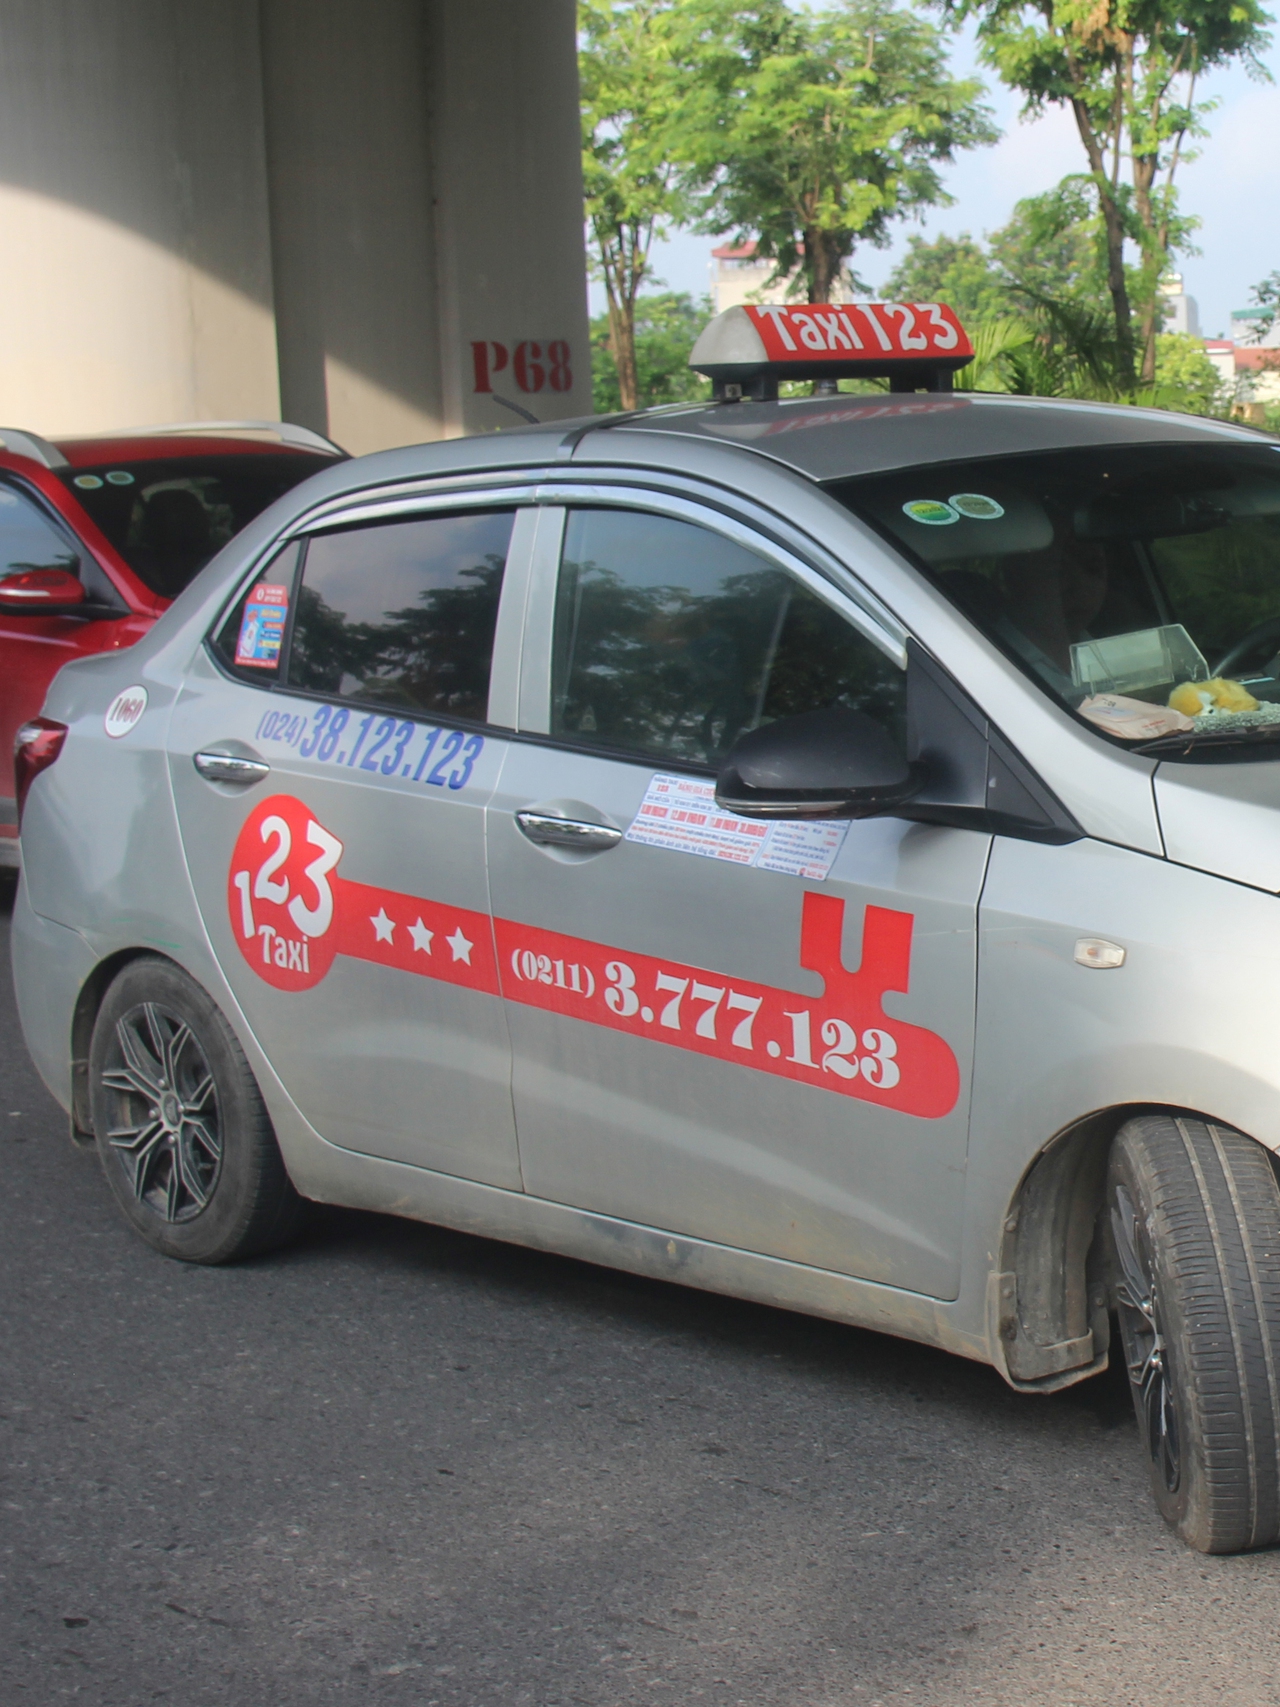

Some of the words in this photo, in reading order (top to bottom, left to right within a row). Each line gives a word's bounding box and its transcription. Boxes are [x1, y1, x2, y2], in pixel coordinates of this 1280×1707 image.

[756, 304, 864, 351] Taxi
[856, 303, 958, 351] 123
[470, 340, 574, 394] P68
[234, 814, 344, 940] 123
[258, 923, 310, 974] Taxi
[511, 948, 595, 998] (0211)
[604, 960, 900, 1090] 3.777.123
